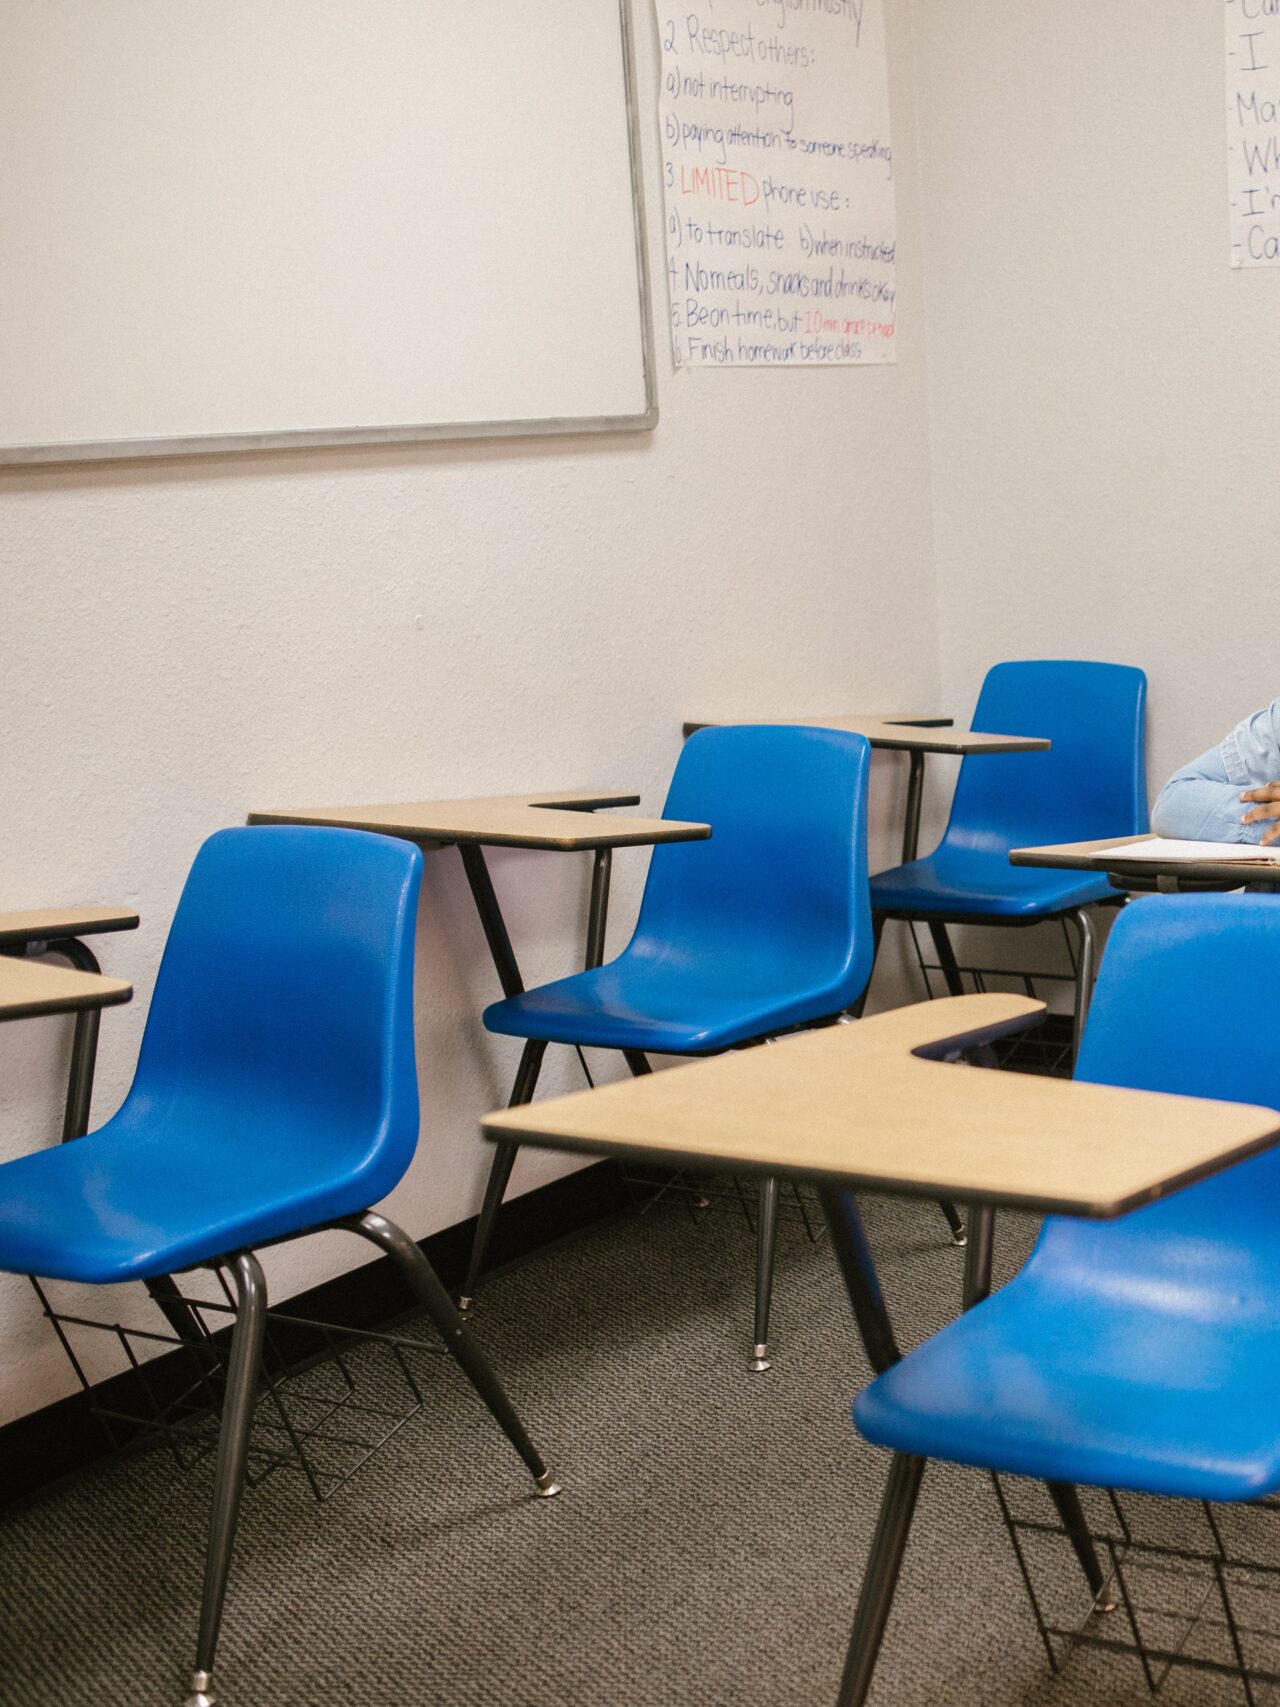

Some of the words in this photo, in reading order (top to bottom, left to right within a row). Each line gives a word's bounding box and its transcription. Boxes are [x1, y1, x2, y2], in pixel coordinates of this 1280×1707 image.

[686, 14, 756, 64] Respect
[1239, 30, 1269, 71] I
[683, 72, 706, 98] not
[682, 123, 727, 165] paying
[727, 122, 782, 149] attention
[680, 163, 760, 206] LIMITED
[762, 174, 807, 212] phone
[685, 216, 703, 244] to
[706, 220, 785, 250] translate
[686, 297, 709, 328] Be
[710, 307, 730, 328] on
[688, 335, 734, 364] Finish
